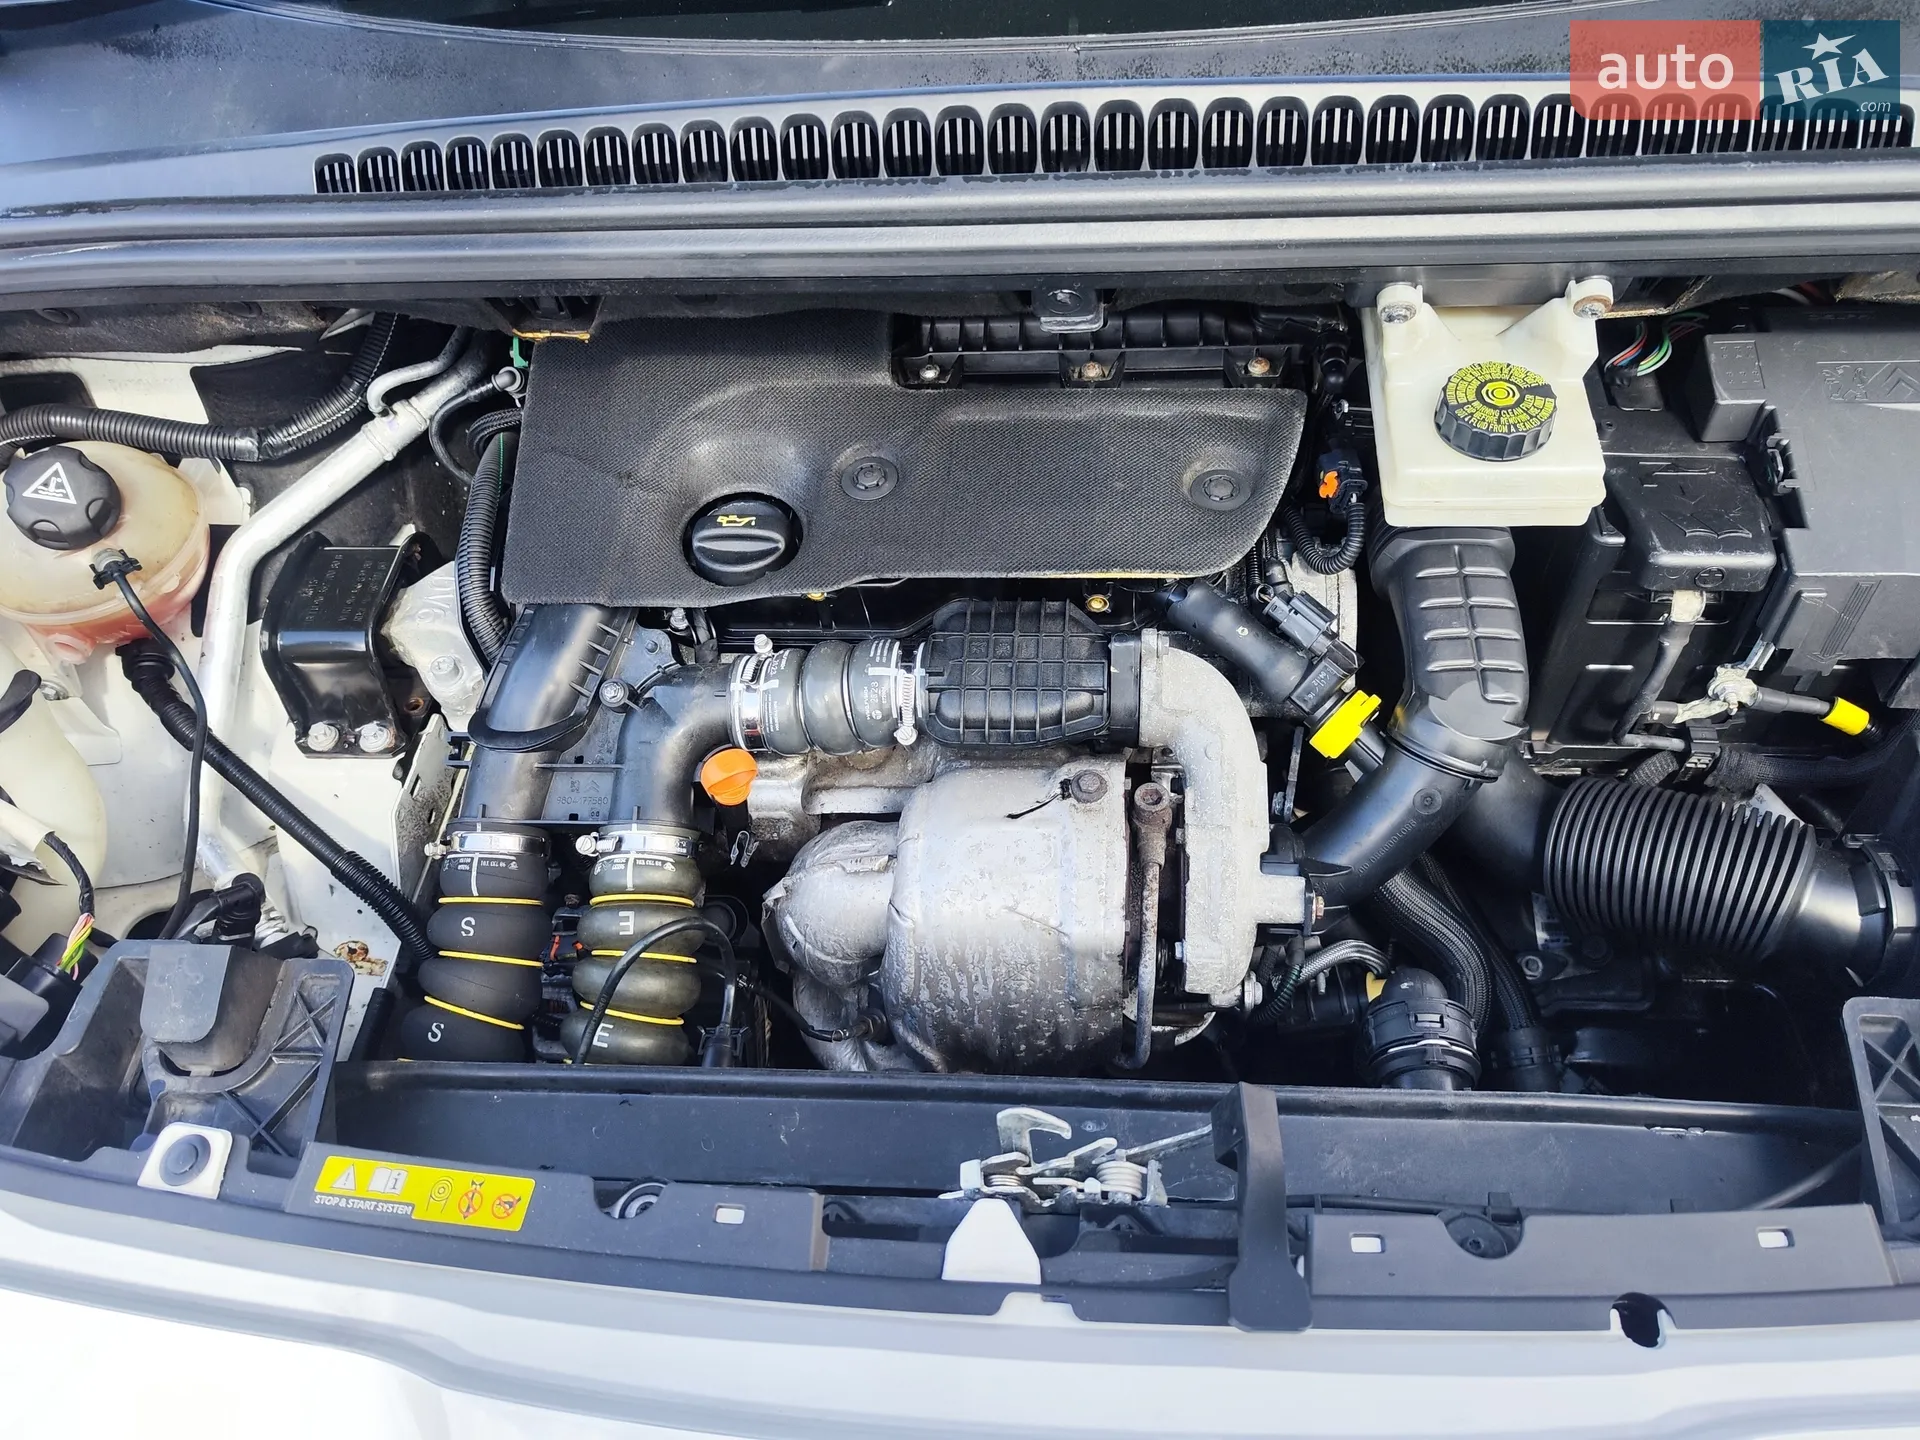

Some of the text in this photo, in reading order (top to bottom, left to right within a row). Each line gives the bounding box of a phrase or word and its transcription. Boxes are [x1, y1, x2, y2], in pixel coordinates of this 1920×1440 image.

[1464, 404, 1476, 414] CAP
[1501, 407, 1526, 416] CLEAN
[1469, 417, 1488, 430] FLUID
[1488, 424, 1508, 433] FROM
[1516, 418, 1540, 432] SEALED
[460, 916, 476, 936] S
[618, 911, 634, 936] E
[428, 1022, 445, 1042] S
[592, 1022, 614, 1048] E
[346, 1198, 376, 1210] START
[376, 1202, 412, 1215] SYSTEM
